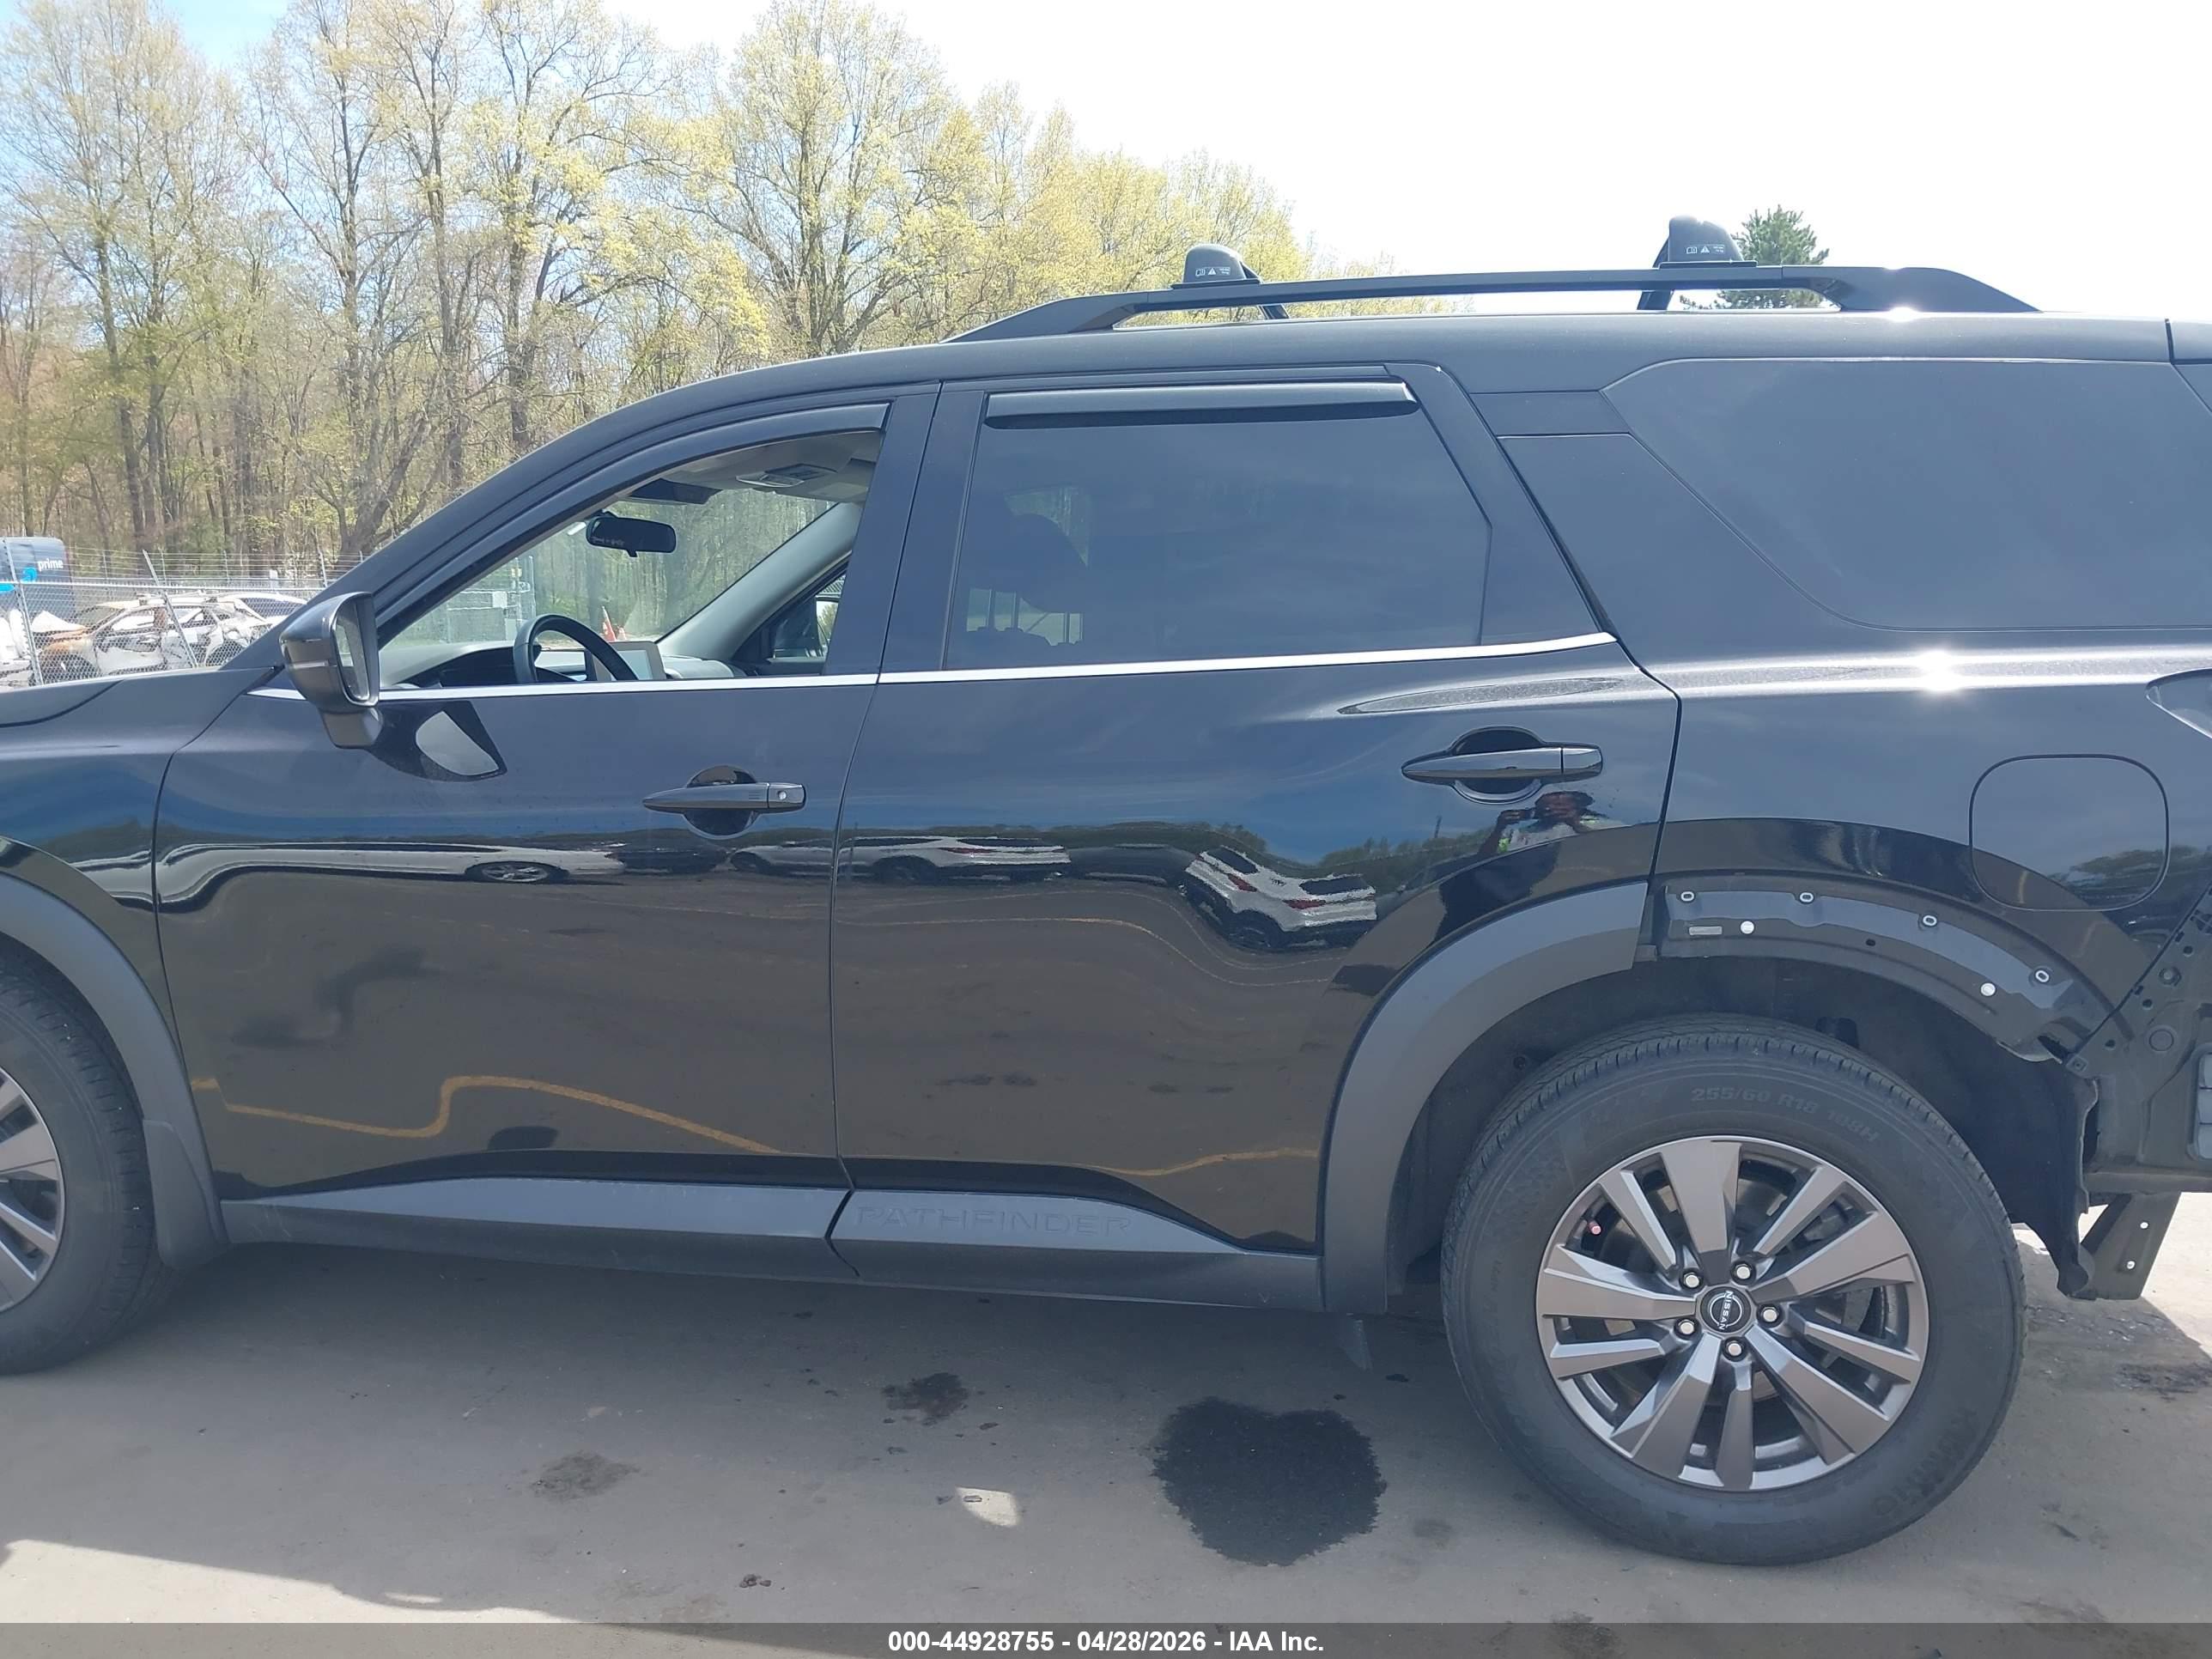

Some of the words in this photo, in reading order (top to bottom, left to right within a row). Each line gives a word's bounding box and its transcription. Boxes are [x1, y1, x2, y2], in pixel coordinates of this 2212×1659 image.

[37, 557, 64, 572] prime
[1690, 1085, 1771, 1103] 255/60
[1777, 1091, 1821, 1115] R18
[857, 1206, 1133, 1237] PATHFINDER
[1718, 1290, 1734, 1330] NISSAN
